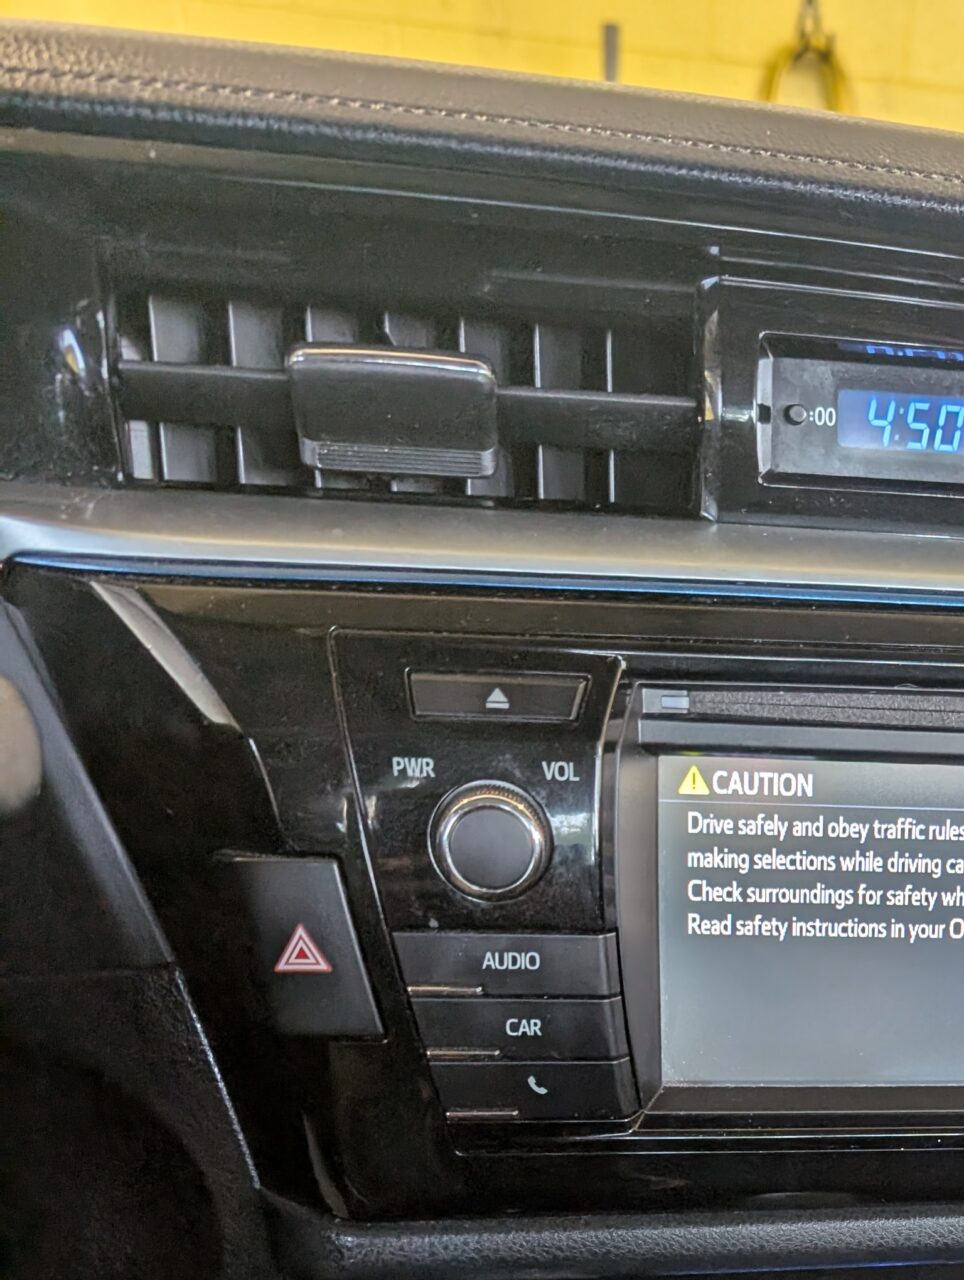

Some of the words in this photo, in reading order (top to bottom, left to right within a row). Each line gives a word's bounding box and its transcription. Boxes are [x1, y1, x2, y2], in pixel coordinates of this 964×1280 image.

[868, 399, 964, 452] 4:50
[392, 757, 436, 779] PWR
[541, 761, 580, 782] VOL
[712, 770, 813, 797] CAUTION
[687, 811, 733, 835] Drive
[738, 814, 788, 841] safely
[792, 815, 823, 837] and
[828, 816, 869, 843] obey
[873, 817, 926, 840] traffic
[687, 846, 749, 874] making
[753, 848, 835, 872] selections
[840, 850, 882, 872] while
[887, 851, 942, 878] driving
[687, 879, 743, 903] Check
[746, 882, 853, 910] surroundings
[857, 884, 883, 906] for
[886, 885, 937, 911] safety
[687, 913, 732, 935] Read
[735, 914, 788, 941] safety
[791, 916, 886, 938] instructions
[890, 918, 905, 939] in
[908, 923, 945, 944] your
[482, 951, 540, 970] AUDIO
[505, 1017, 542, 1037] CAR
